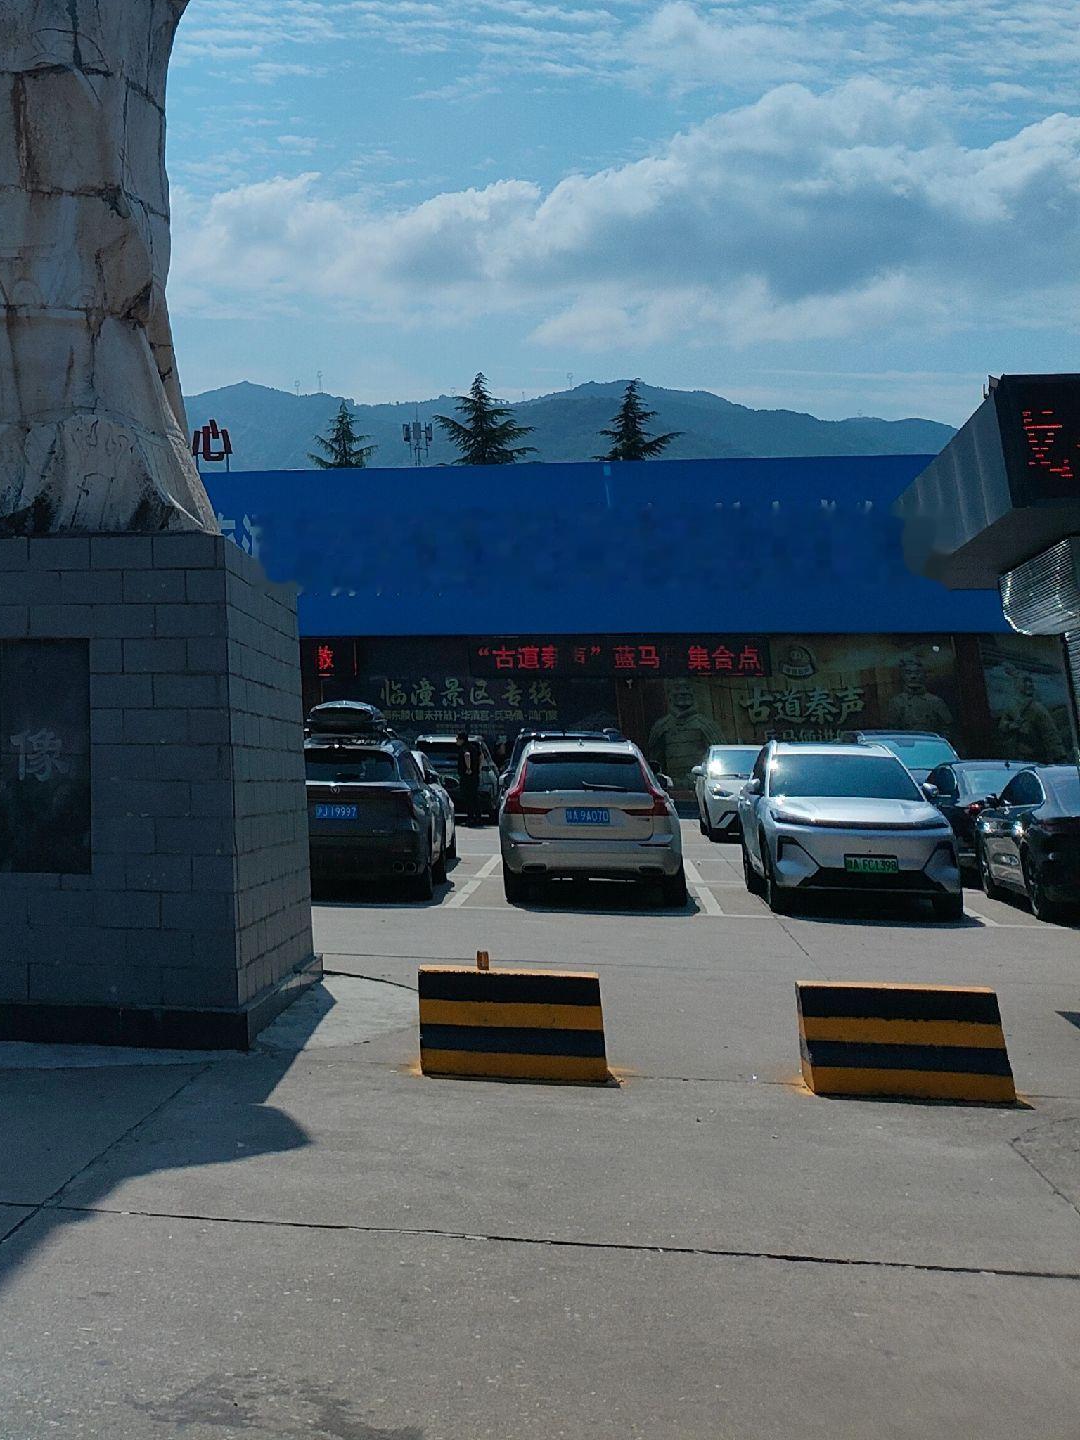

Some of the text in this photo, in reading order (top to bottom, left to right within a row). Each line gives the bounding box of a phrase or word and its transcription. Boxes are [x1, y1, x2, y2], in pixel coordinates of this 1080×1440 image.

[192, 419, 232, 461] 心
[740, 686, 865, 726] 古道秦声
